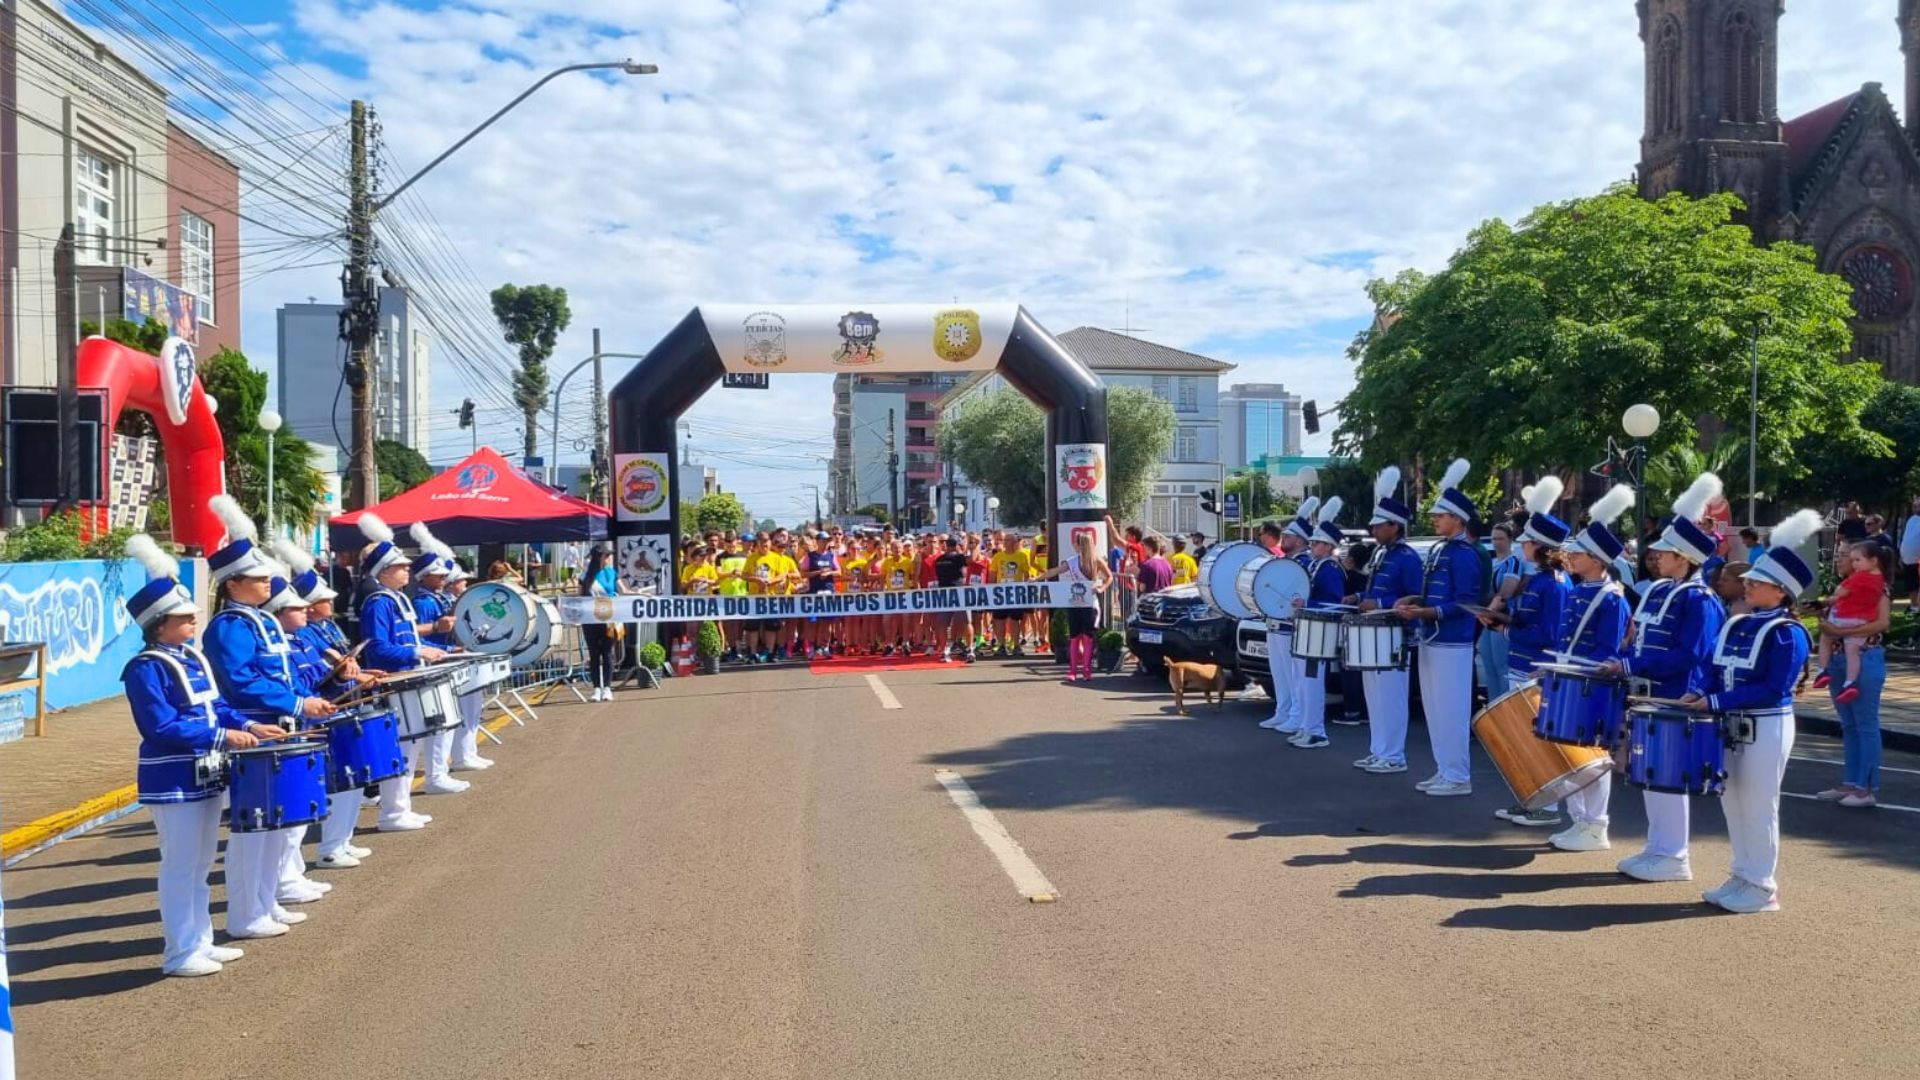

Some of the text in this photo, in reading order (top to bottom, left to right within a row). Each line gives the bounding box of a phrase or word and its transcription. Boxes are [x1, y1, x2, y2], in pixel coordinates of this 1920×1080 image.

[846, 322, 873, 338] Bem
[632, 598, 719, 619] CORRIDA
[725, 599, 750, 617] DO
[755, 596, 795, 615] BEM
[801, 592, 880, 613] CAMPOS
[885, 591, 907, 610] DE
[911, 588, 959, 609] CIMA
[964, 586, 990, 607] DA
[993, 584, 1052, 606] SERRA
